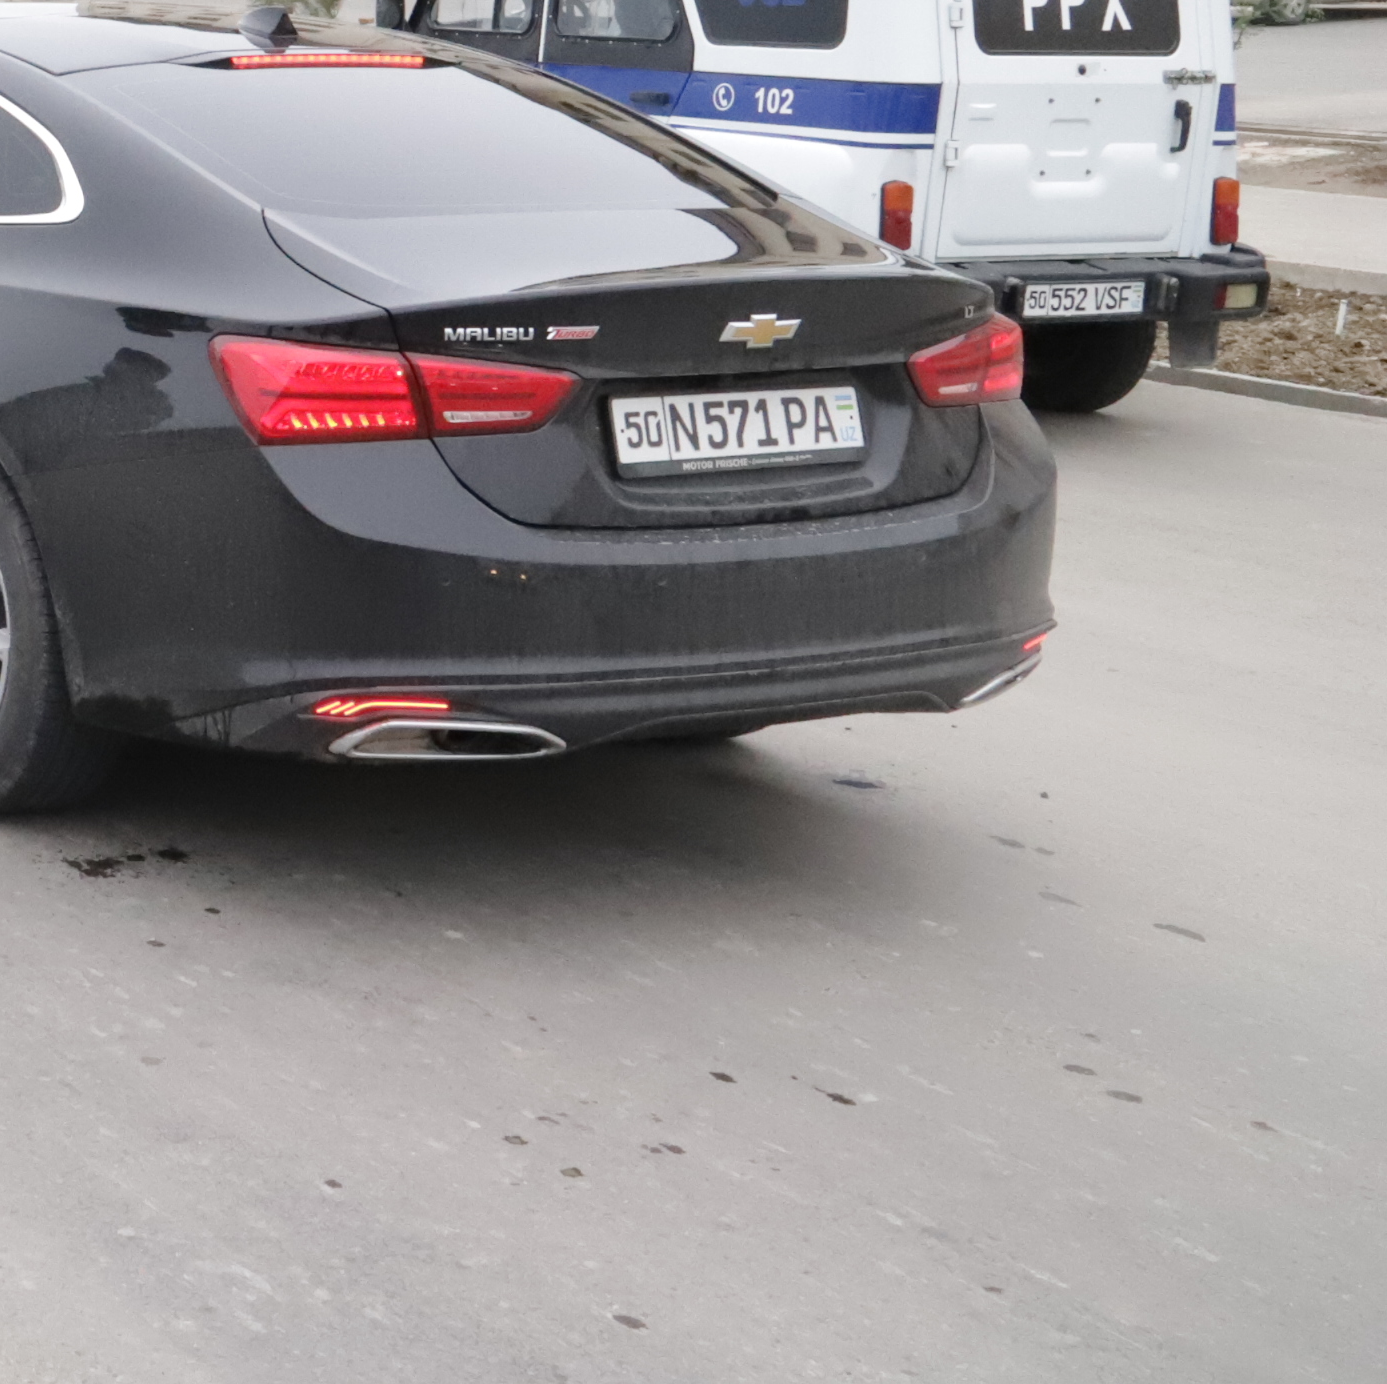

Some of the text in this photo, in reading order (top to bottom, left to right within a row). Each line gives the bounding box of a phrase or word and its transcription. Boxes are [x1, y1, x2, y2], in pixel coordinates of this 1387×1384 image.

[754, 87, 795, 114] 102
[1028, 285, 1132, 312] 50 552 VSF
[443, 327, 535, 341] MALIBU
[623, 410, 663, 449] 50
[839, 426, 859, 443] UZ
[682, 457, 714, 471] MOTOR
